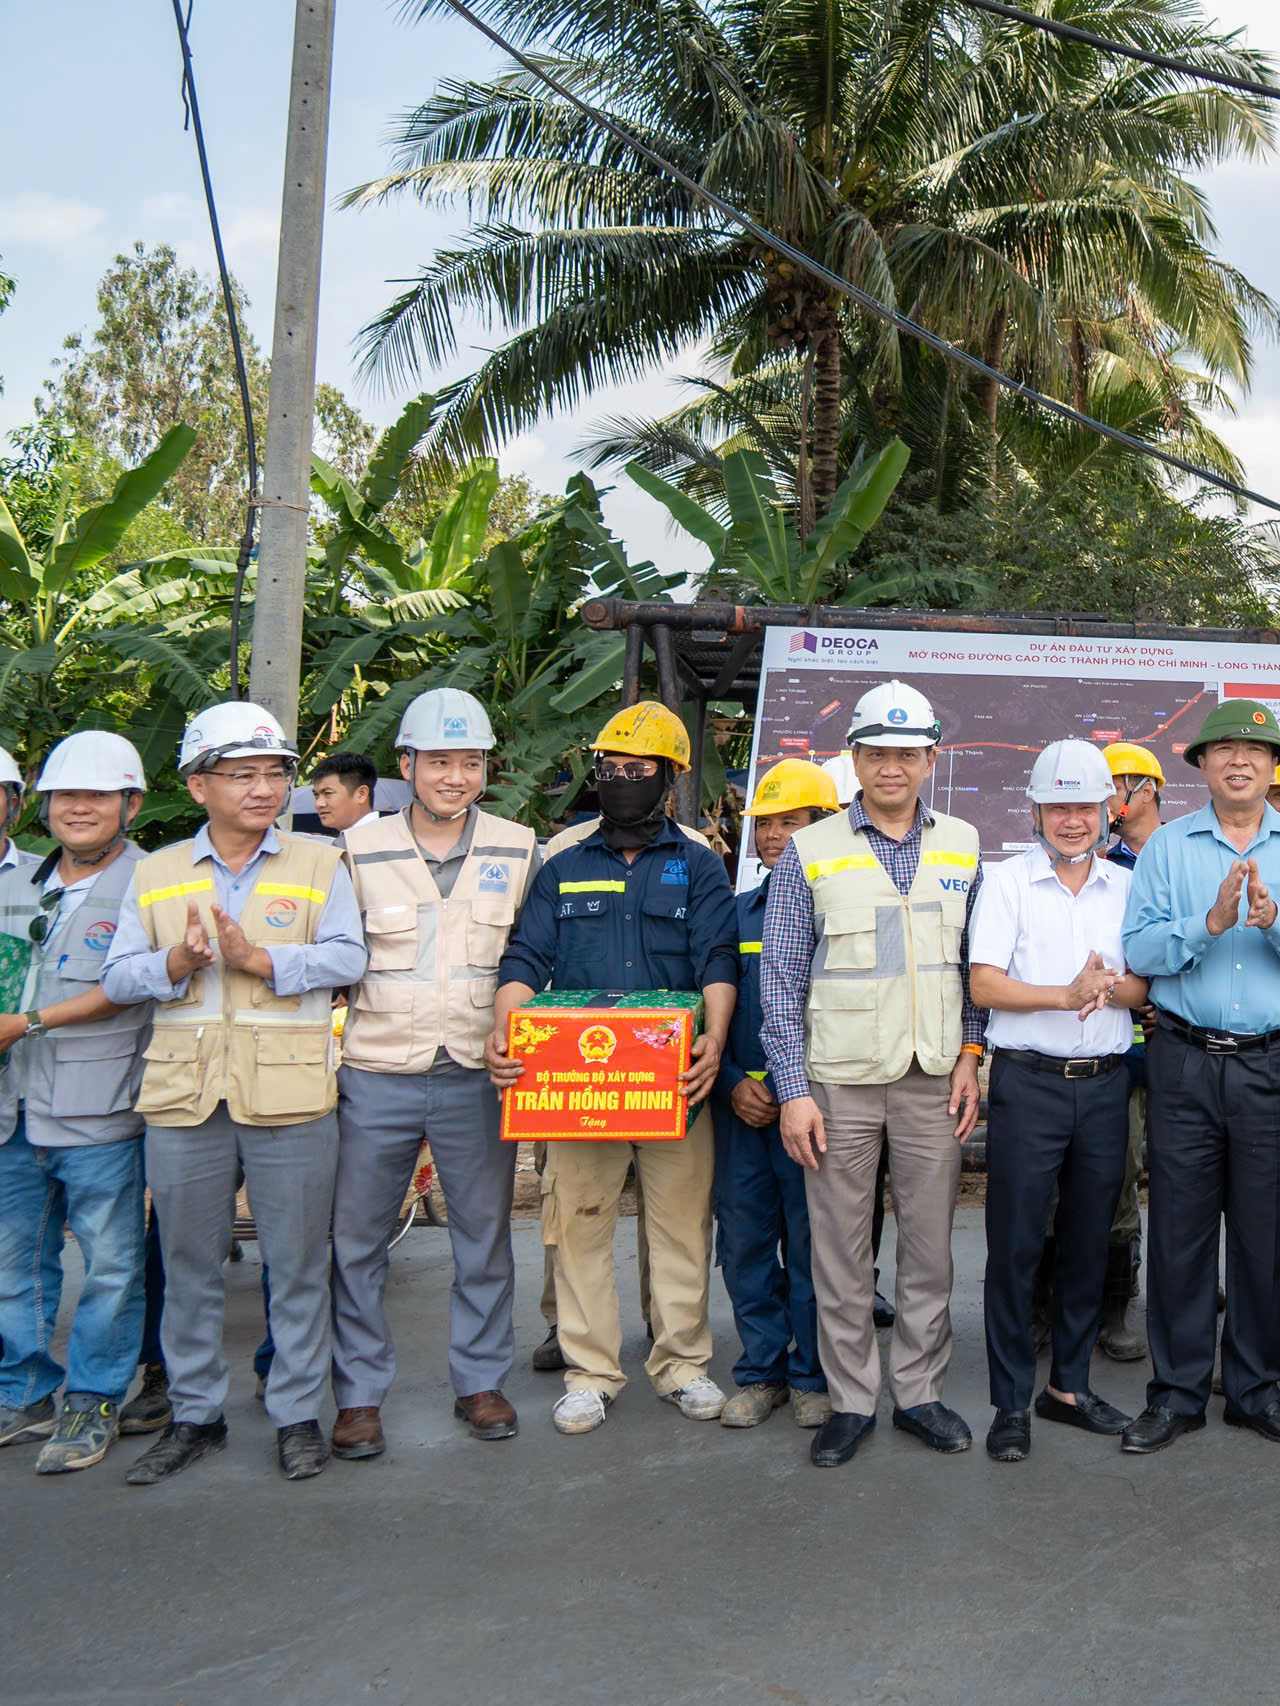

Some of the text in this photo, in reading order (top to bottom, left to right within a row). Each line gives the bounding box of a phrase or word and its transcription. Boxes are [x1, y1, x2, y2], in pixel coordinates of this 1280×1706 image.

[821, 637, 879, 650] DEOCA
[1015, 654, 1040, 663] CAO
[1180, 660, 1208, 669] MINH
[1217, 661, 1249, 670] LONG
[938, 878, 969, 893] VEC
[536, 1070, 550, 1084] BỘ
[591, 1070, 605, 1085] BỘ
[607, 1070, 626, 1083] XÂY
[628, 1071, 655, 1085] DỰNG
[515, 1085, 673, 1111] TRẦN HỒNG MINH
[579, 1116, 607, 1129] Tặng
